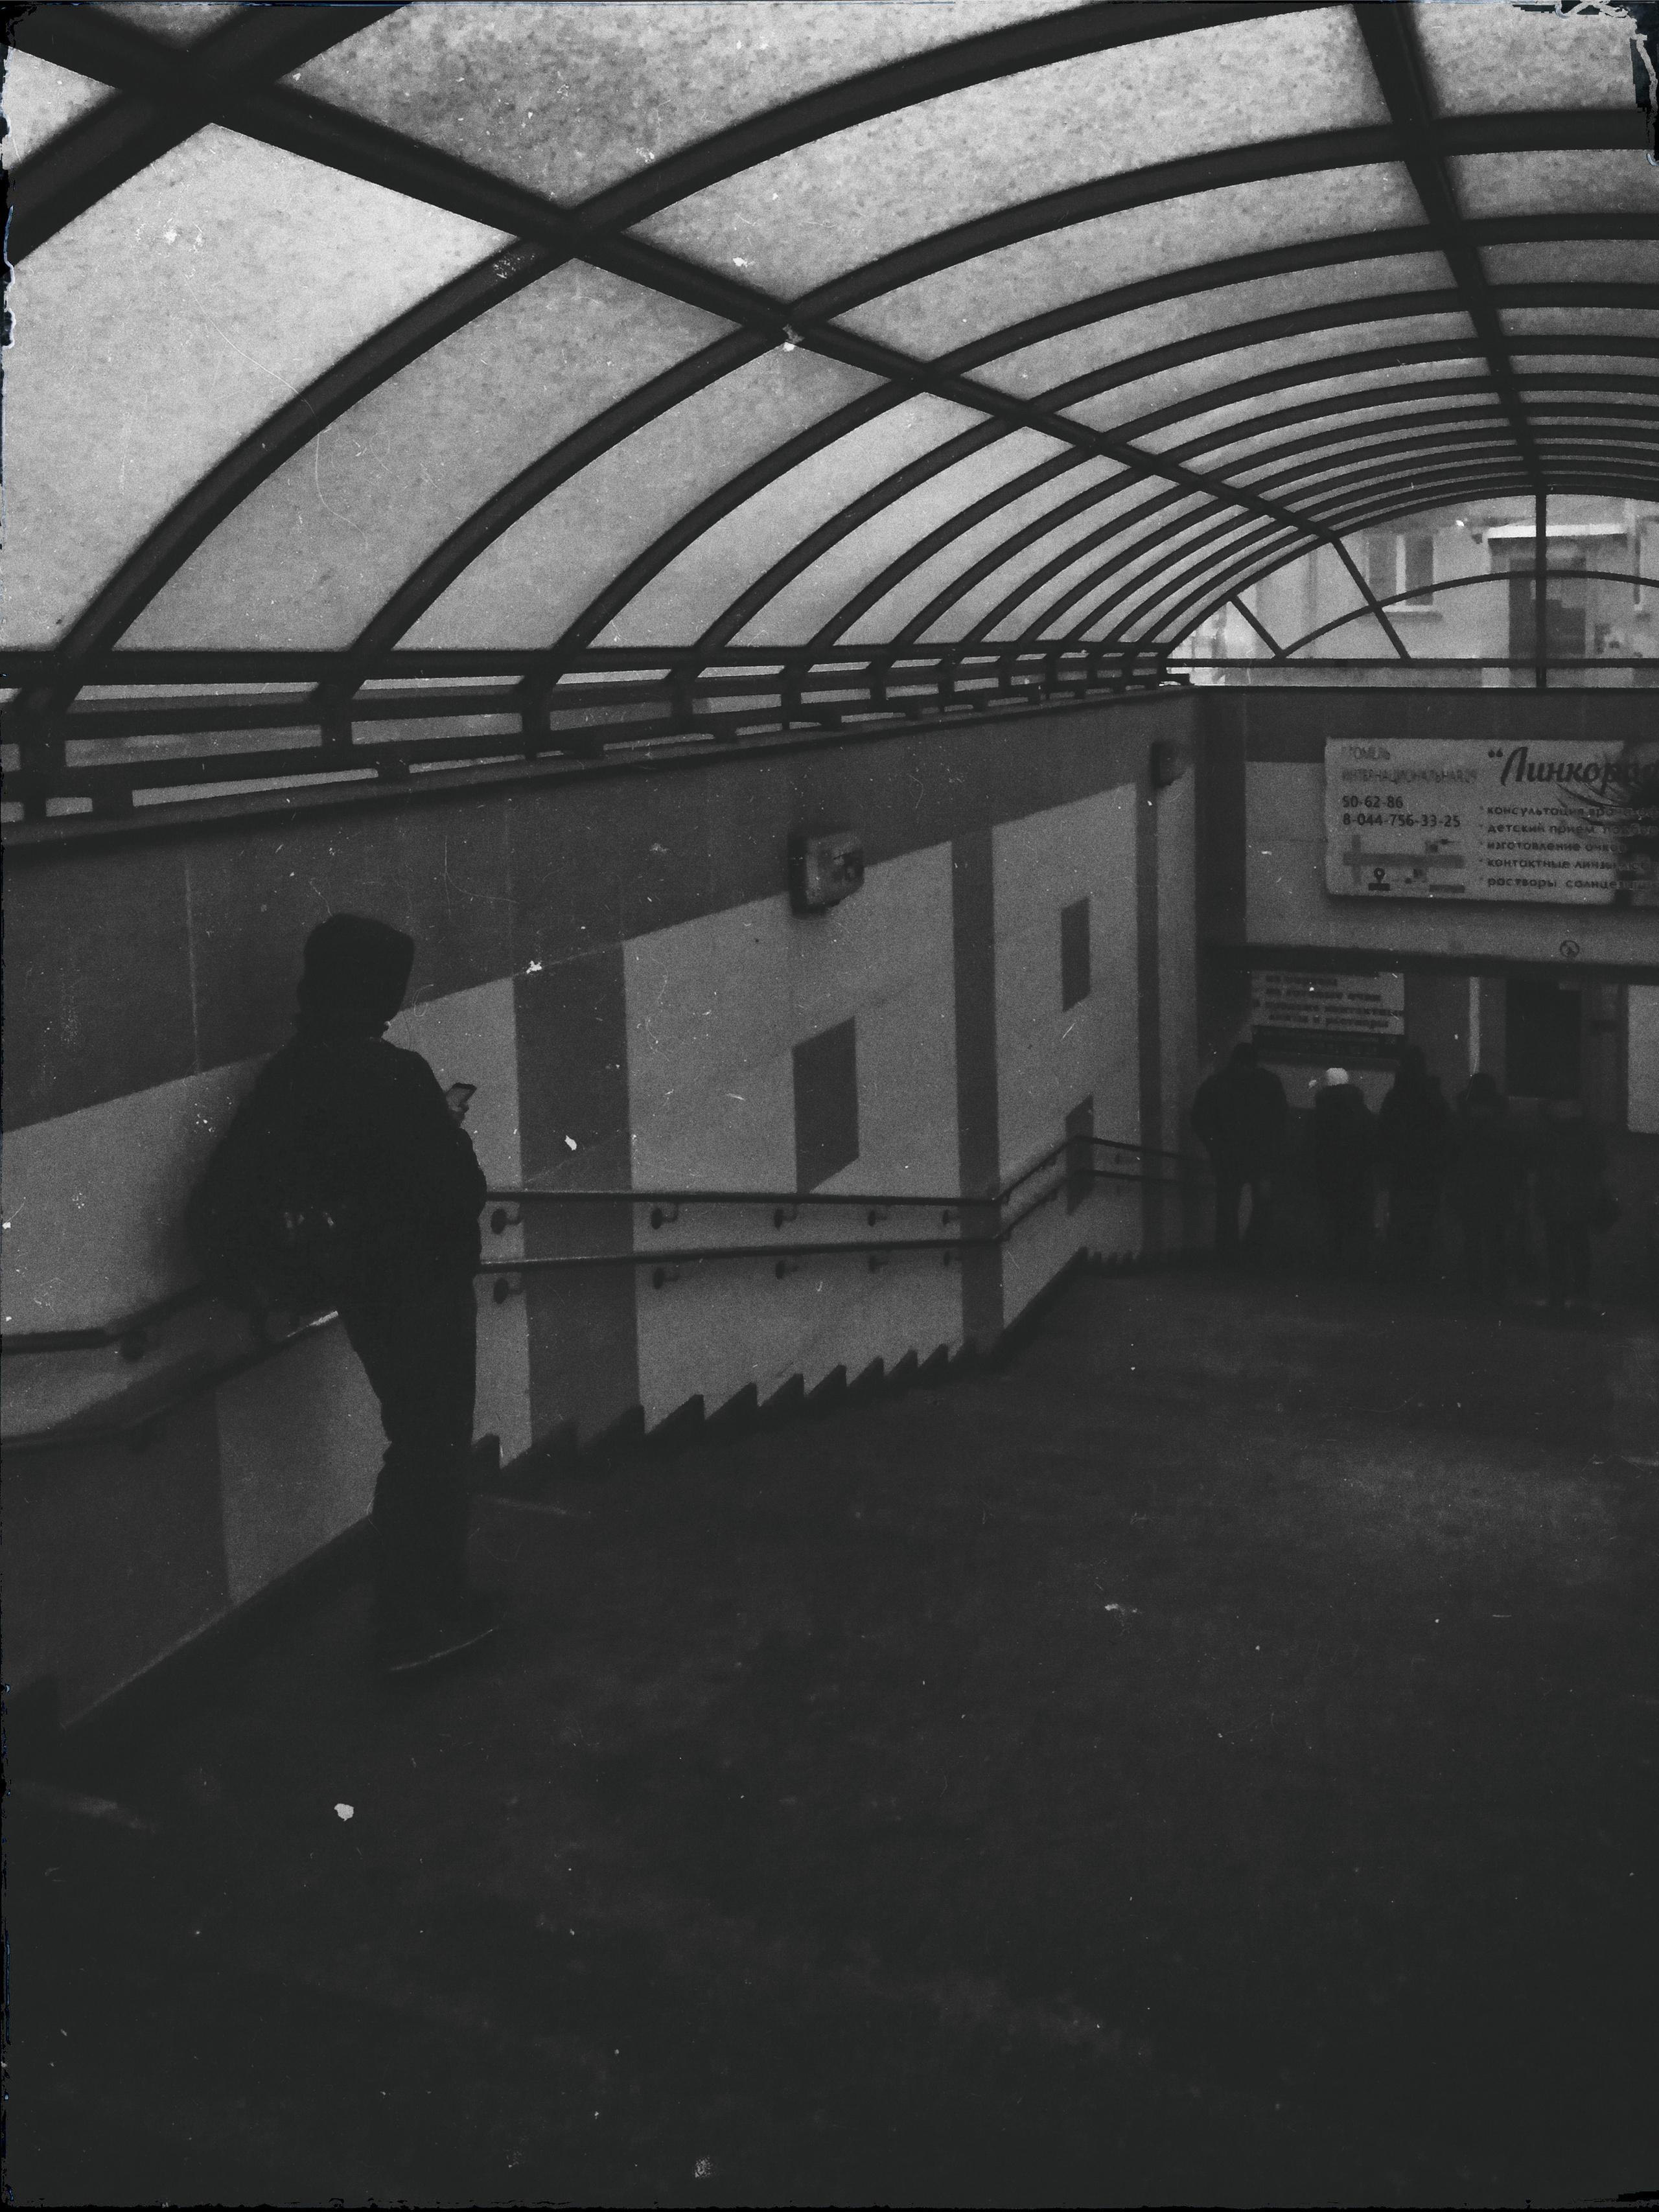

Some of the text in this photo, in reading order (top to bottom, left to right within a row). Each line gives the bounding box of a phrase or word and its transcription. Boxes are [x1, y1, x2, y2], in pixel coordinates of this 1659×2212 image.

[1342, 795, 1404, 809] 50-62-86
[1487, 807, 1584, 818] консультация
[1342, 812, 1461, 827] 8-044-756-33-25
[1487, 823, 1545, 834] детский
[1549, 825, 1595, 835] прием
[1487, 842, 1581, 852] изготовление
[1487, 858, 1570, 869] контактные
[1487, 877, 1557, 890] растворы
